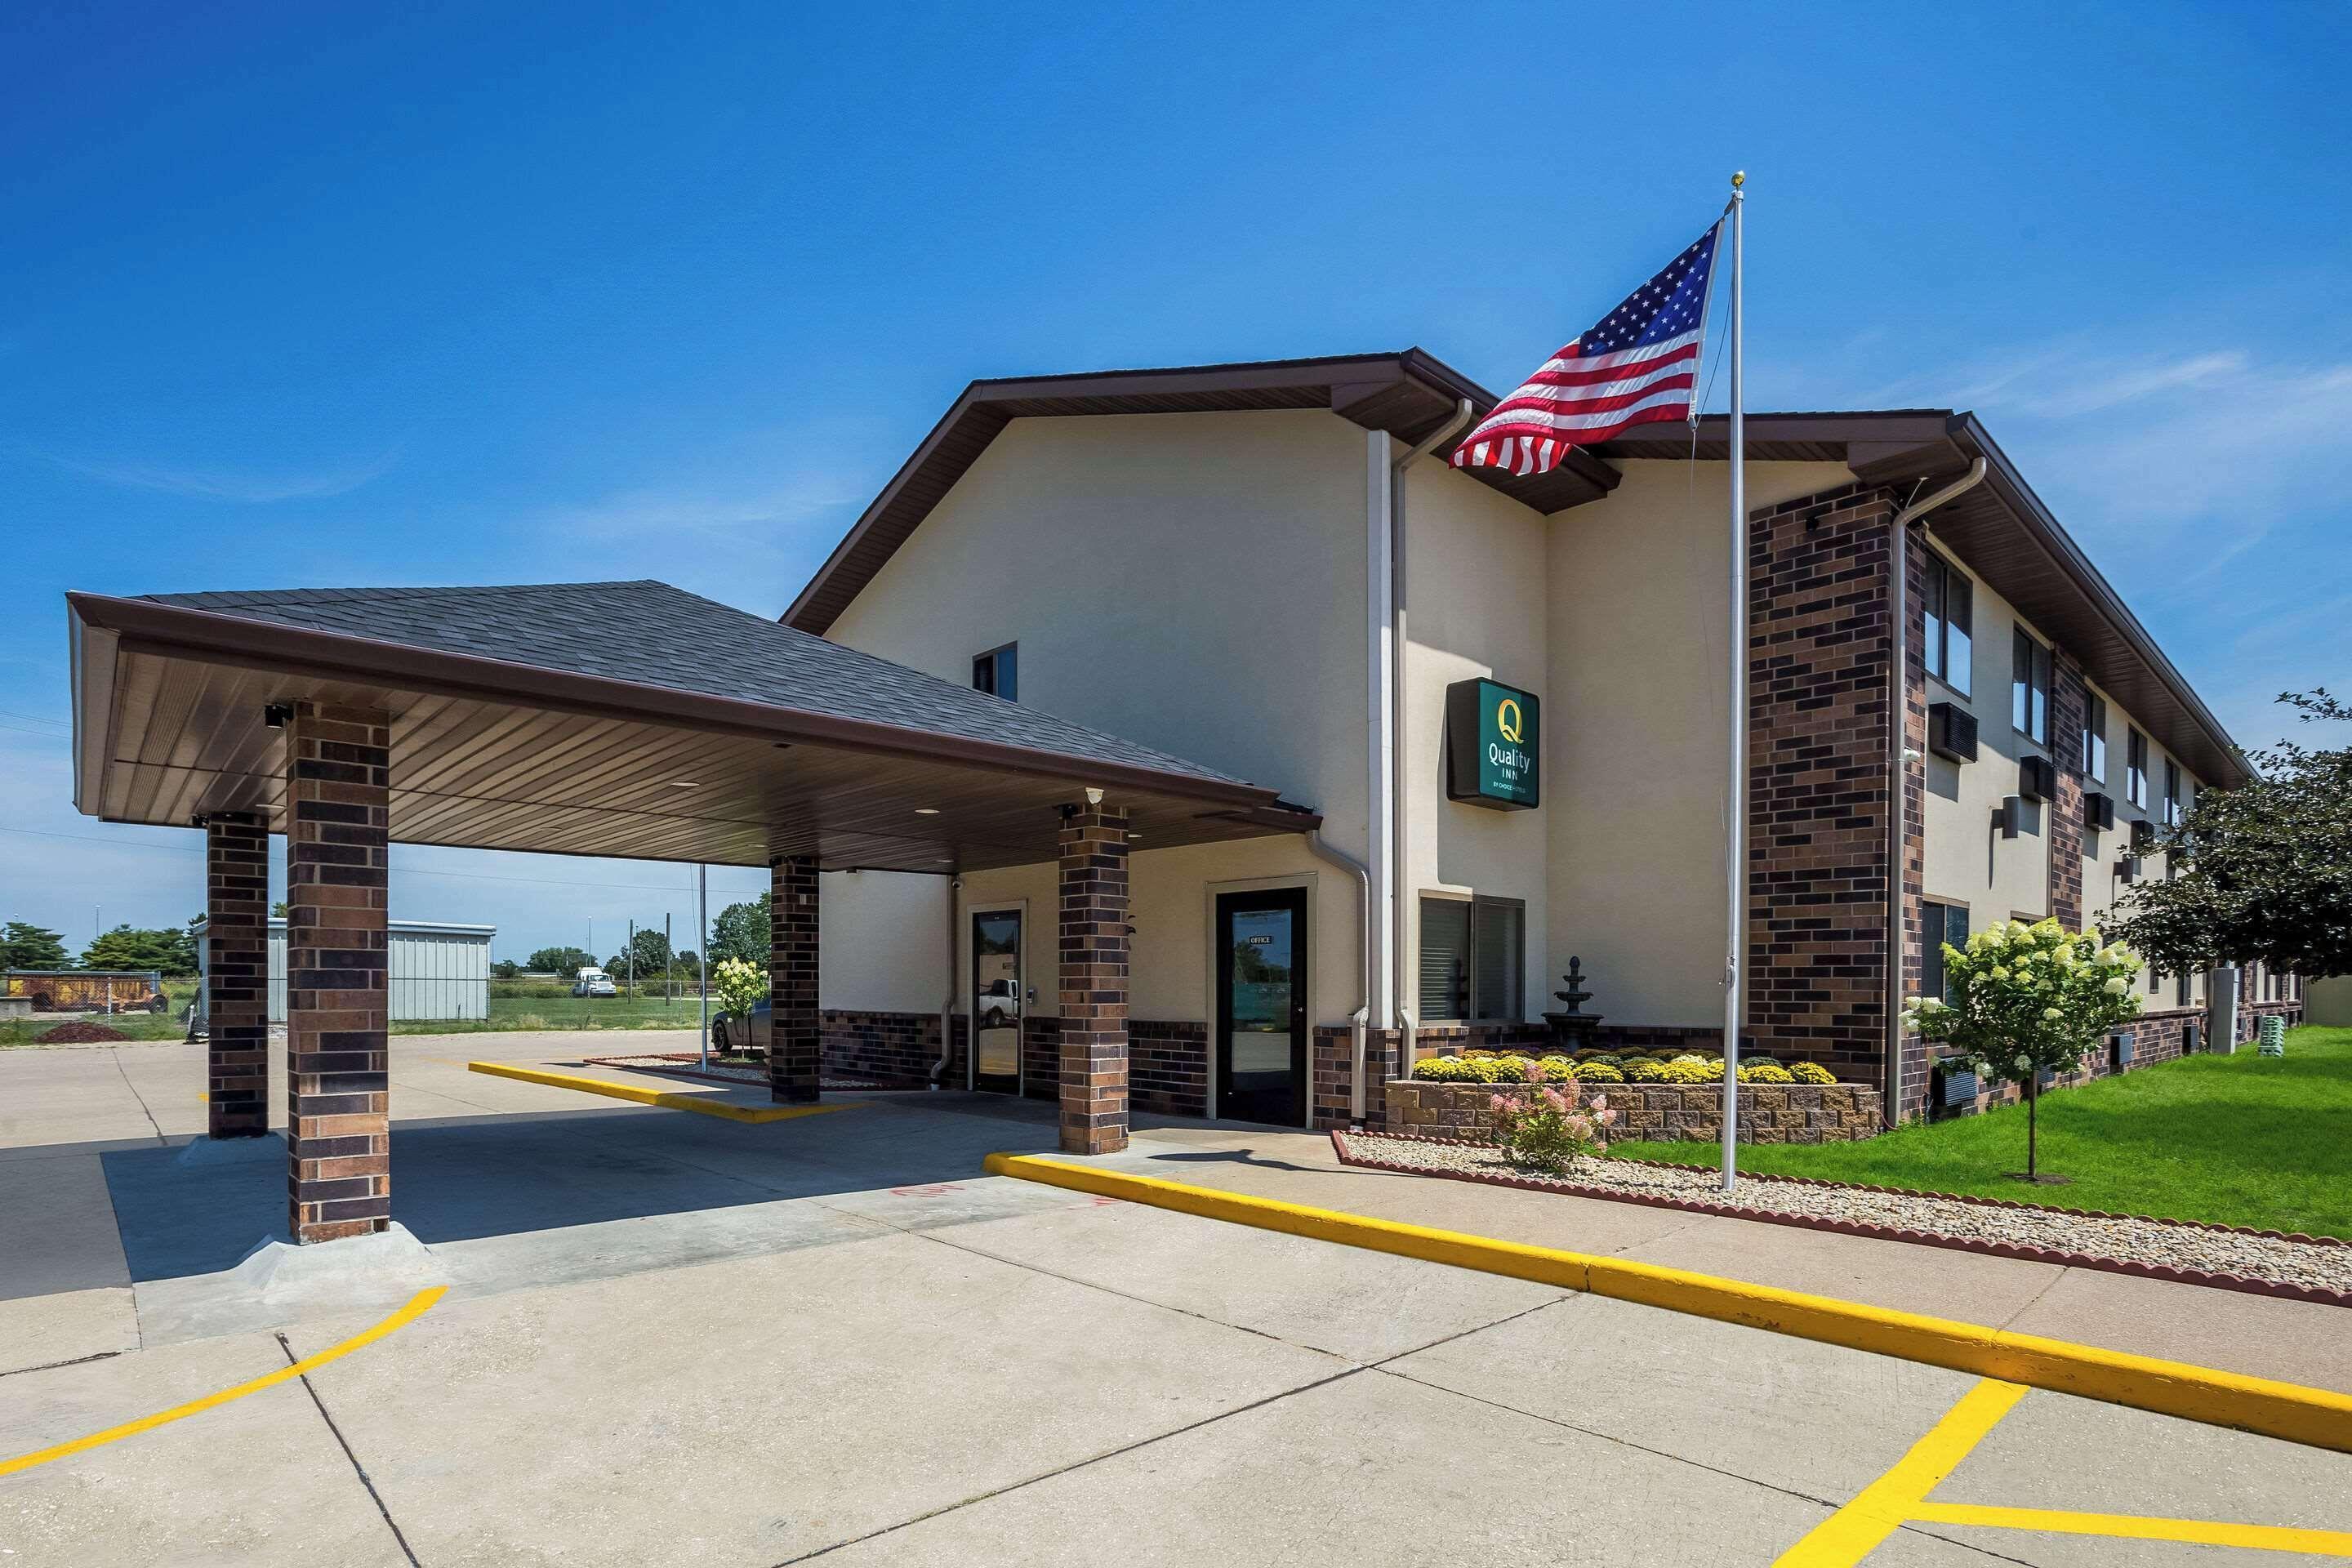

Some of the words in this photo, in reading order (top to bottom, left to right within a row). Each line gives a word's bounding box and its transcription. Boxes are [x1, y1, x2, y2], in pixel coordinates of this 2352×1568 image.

[1498, 699, 1524, 744] Q
[1489, 743, 1530, 774] Quality
[1502, 768, 1518, 781] INN
